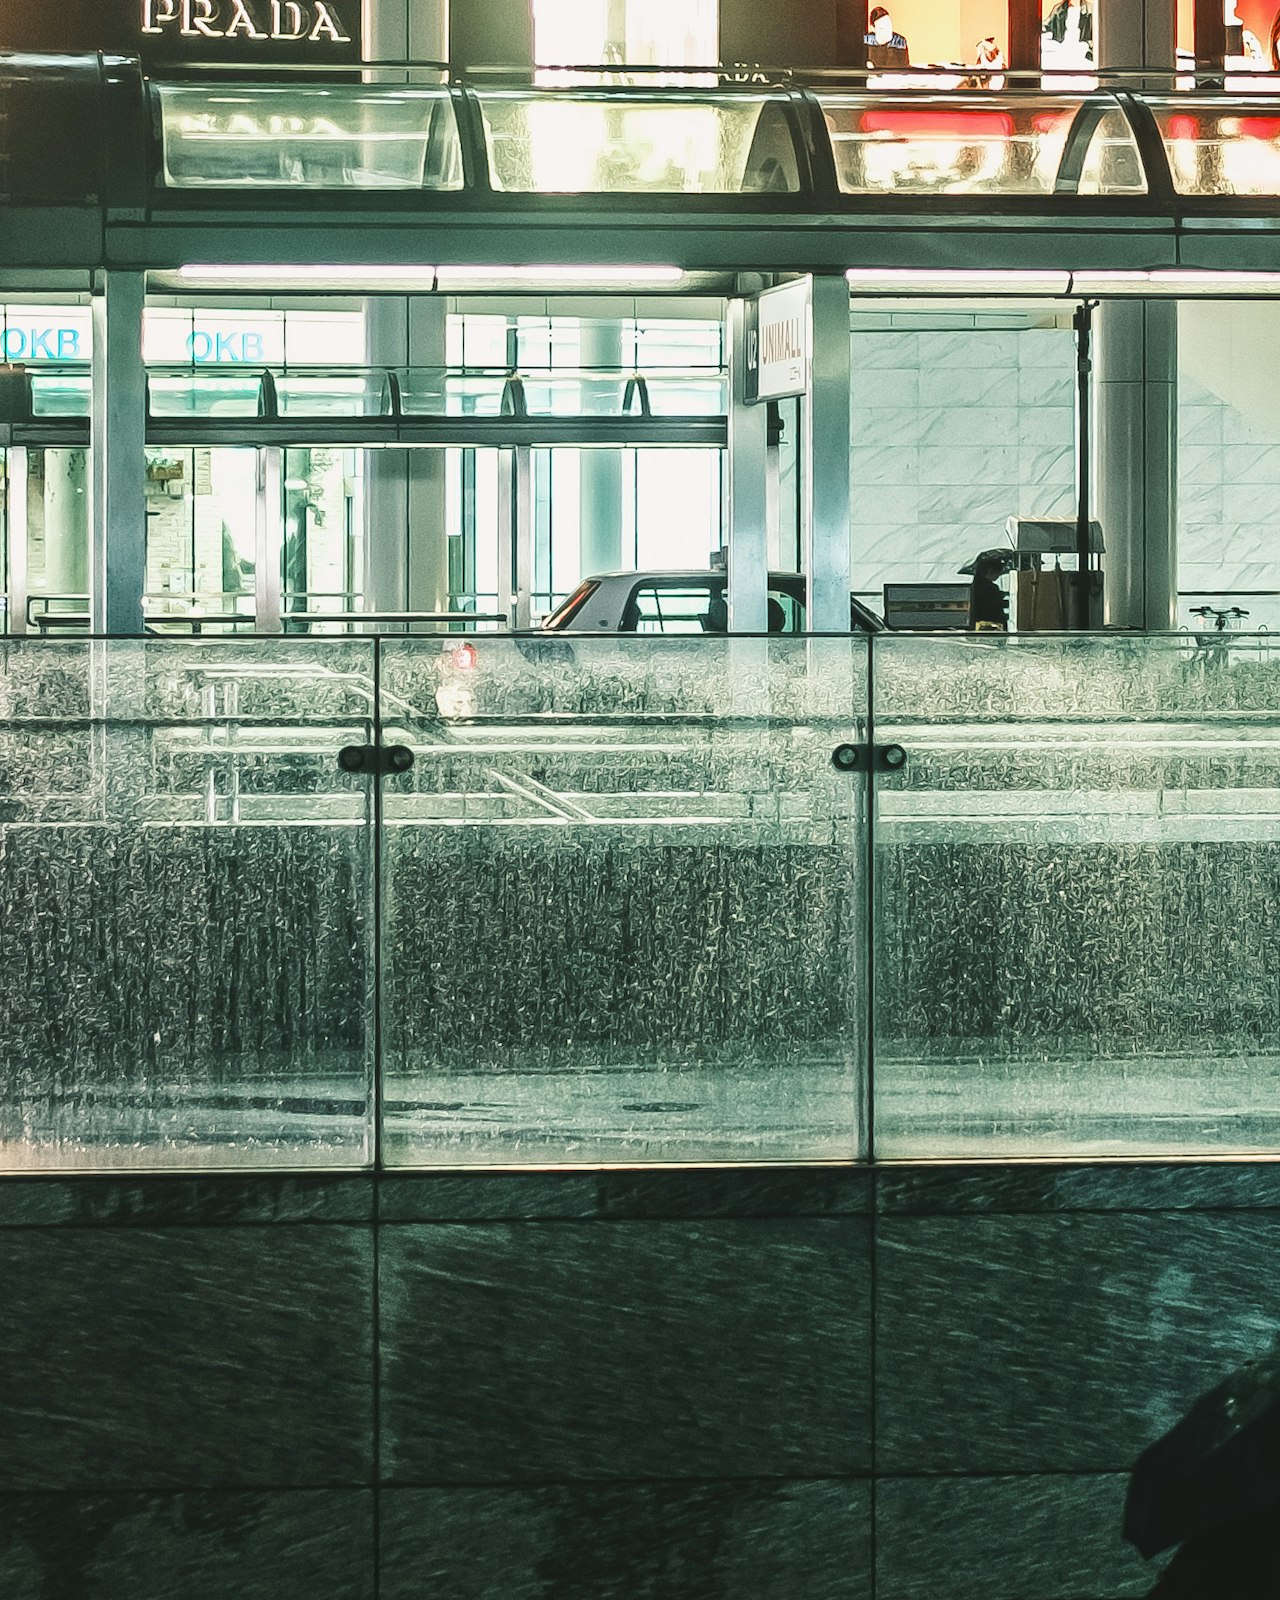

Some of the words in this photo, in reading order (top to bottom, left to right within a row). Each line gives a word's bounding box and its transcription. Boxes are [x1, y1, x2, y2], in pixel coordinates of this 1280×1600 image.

[0, 327, 81, 359] OKB
[186, 331, 265, 362] OKB
[762, 316, 802, 365] UNIMALL
